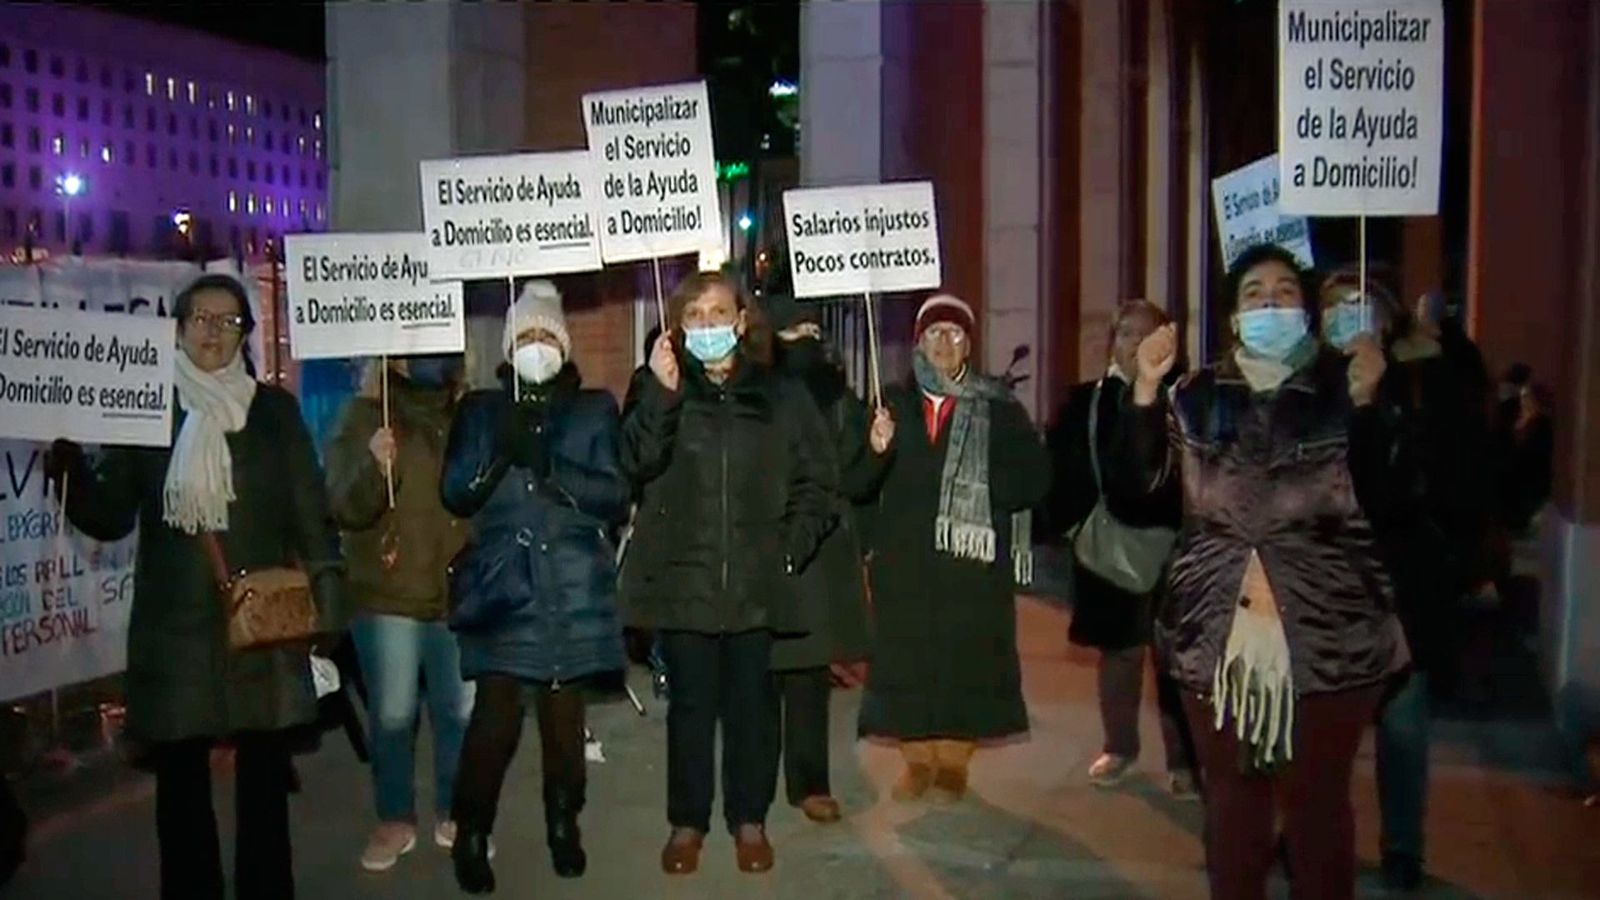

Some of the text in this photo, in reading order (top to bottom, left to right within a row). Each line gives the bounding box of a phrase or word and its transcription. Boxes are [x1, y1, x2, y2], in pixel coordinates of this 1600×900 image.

[1288, 10, 1431, 49] Municipalizar
[1305, 57, 1415, 91] el Servicio
[590, 96, 698, 127] Municipalizar
[1297, 106, 1418, 148] de la Ayuda
[605, 132, 691, 161] el Servicio
[604, 168, 698, 201] de la Ayuda
[1293, 155, 1418, 188] a Domicilio!
[438, 173, 581, 207] El Servicio de Ayuda
[432, 213, 594, 247] a Domicilio es esencial.
[607, 205, 702, 235] a Domicilio!
[793, 208, 929, 237] Salarios injustos
[303, 256, 318, 282] El
[320, 255, 378, 281] Servicio
[381, 255, 398, 279] de
[401, 253, 428, 286] Ayu
[795, 248, 936, 274] Pocos contratos.
[296, 294, 456, 324] a Domicilio es esencial.
[13, 330, 80, 361] Servicio
[84, 335, 104, 363] de
[106, 335, 158, 372] Ayuda
[78, 384, 95, 407] es
[101, 383, 167, 411] esencial.
